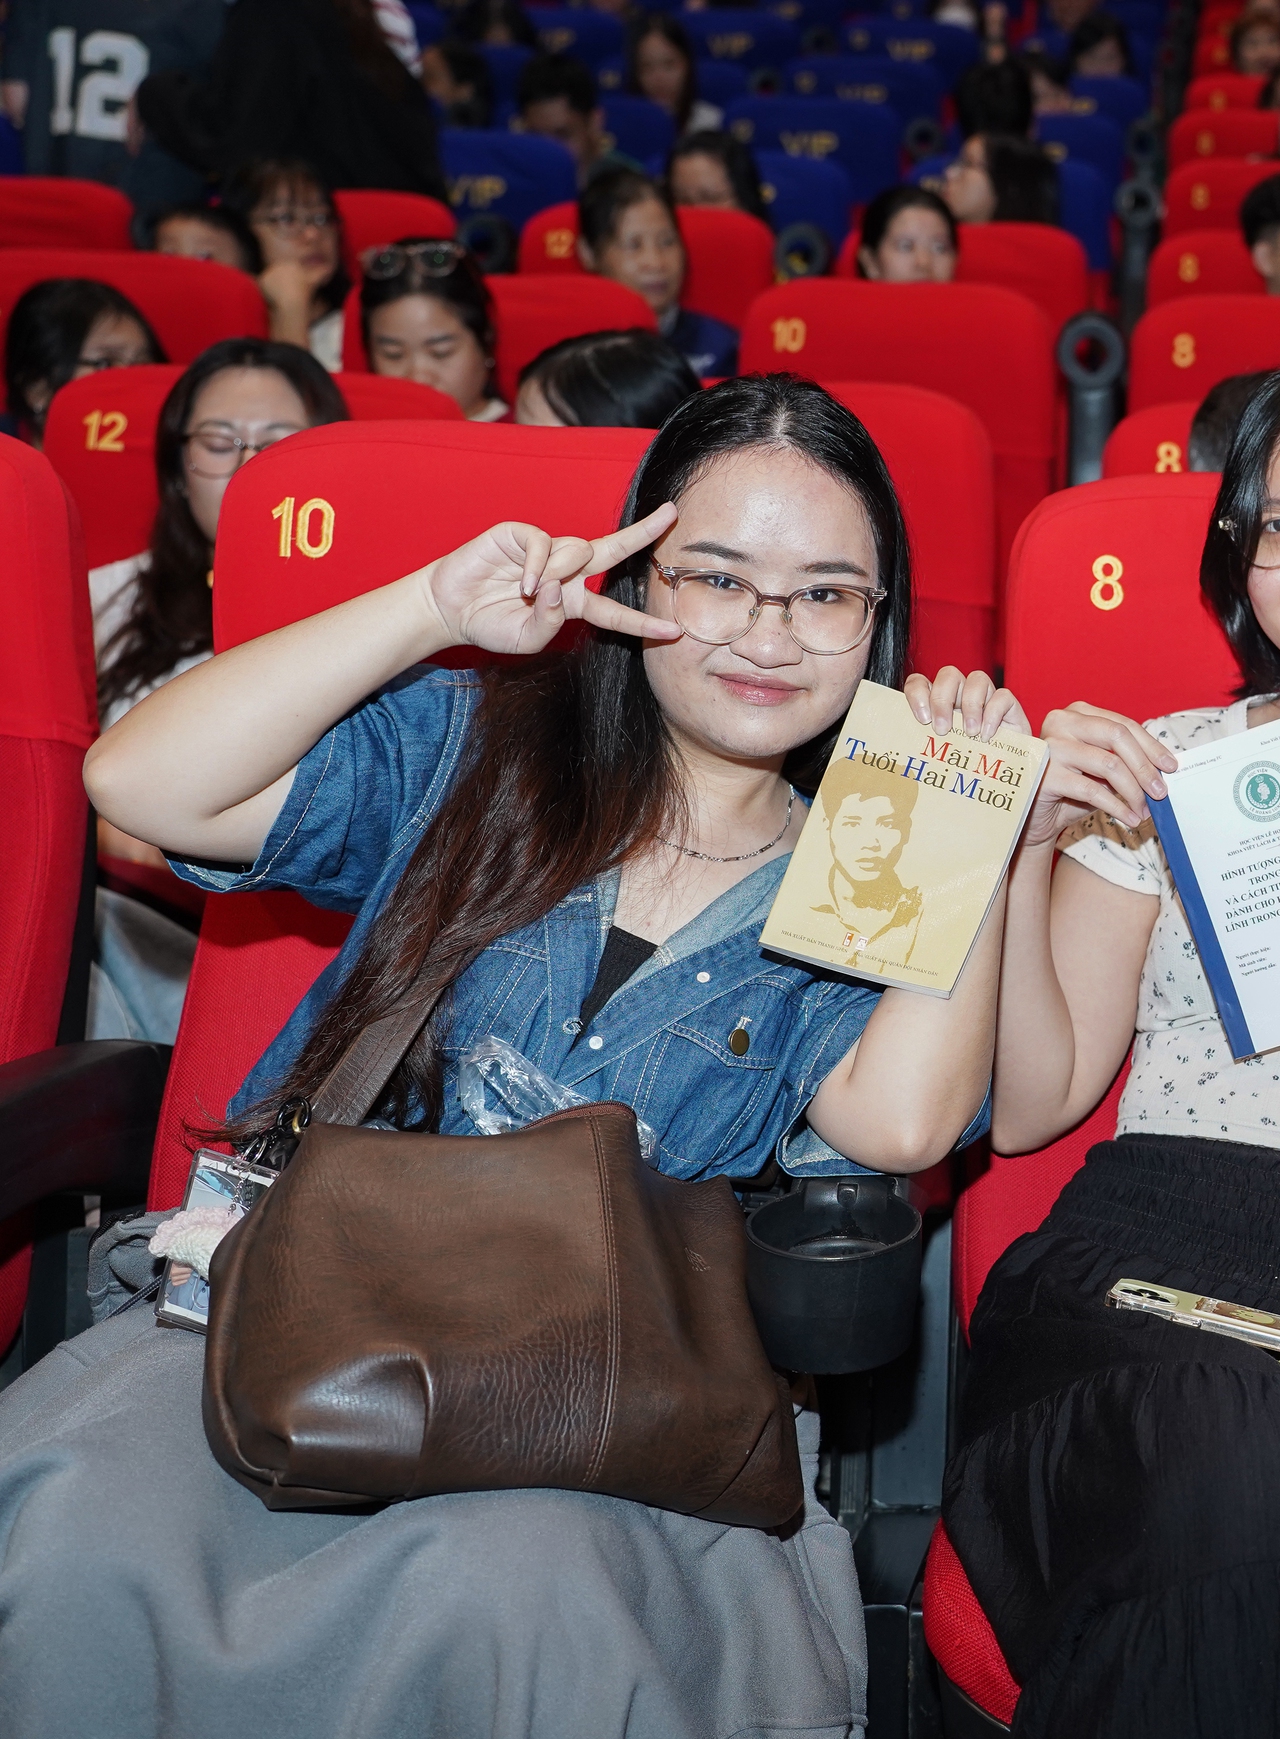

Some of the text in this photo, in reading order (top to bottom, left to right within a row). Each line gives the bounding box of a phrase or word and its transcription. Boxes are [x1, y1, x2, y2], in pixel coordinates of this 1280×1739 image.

[49, 27, 150, 141] 12
[1178, 252, 1199, 284] 8
[771, 316, 807, 353] 10
[1171, 332, 1197, 369] 8
[83, 411, 128, 452] 12
[272, 497, 335, 558] 10
[1090, 554, 1124, 611] 8
[845, 737, 1015, 812] Tuổi Hai Mươi
[920, 735, 1024, 788] Mãi Mãi
[1221, 868, 1246, 881] HÌNH
[1246, 856, 1280, 872] TƯỢNG
[1225, 895, 1239, 905] VÀ
[1240, 887, 1268, 901] CÁCH
[1226, 905, 1253, 919] DÀNH
[1254, 898, 1275, 910] CHO
[1225, 919, 1249, 932] LÍNH
